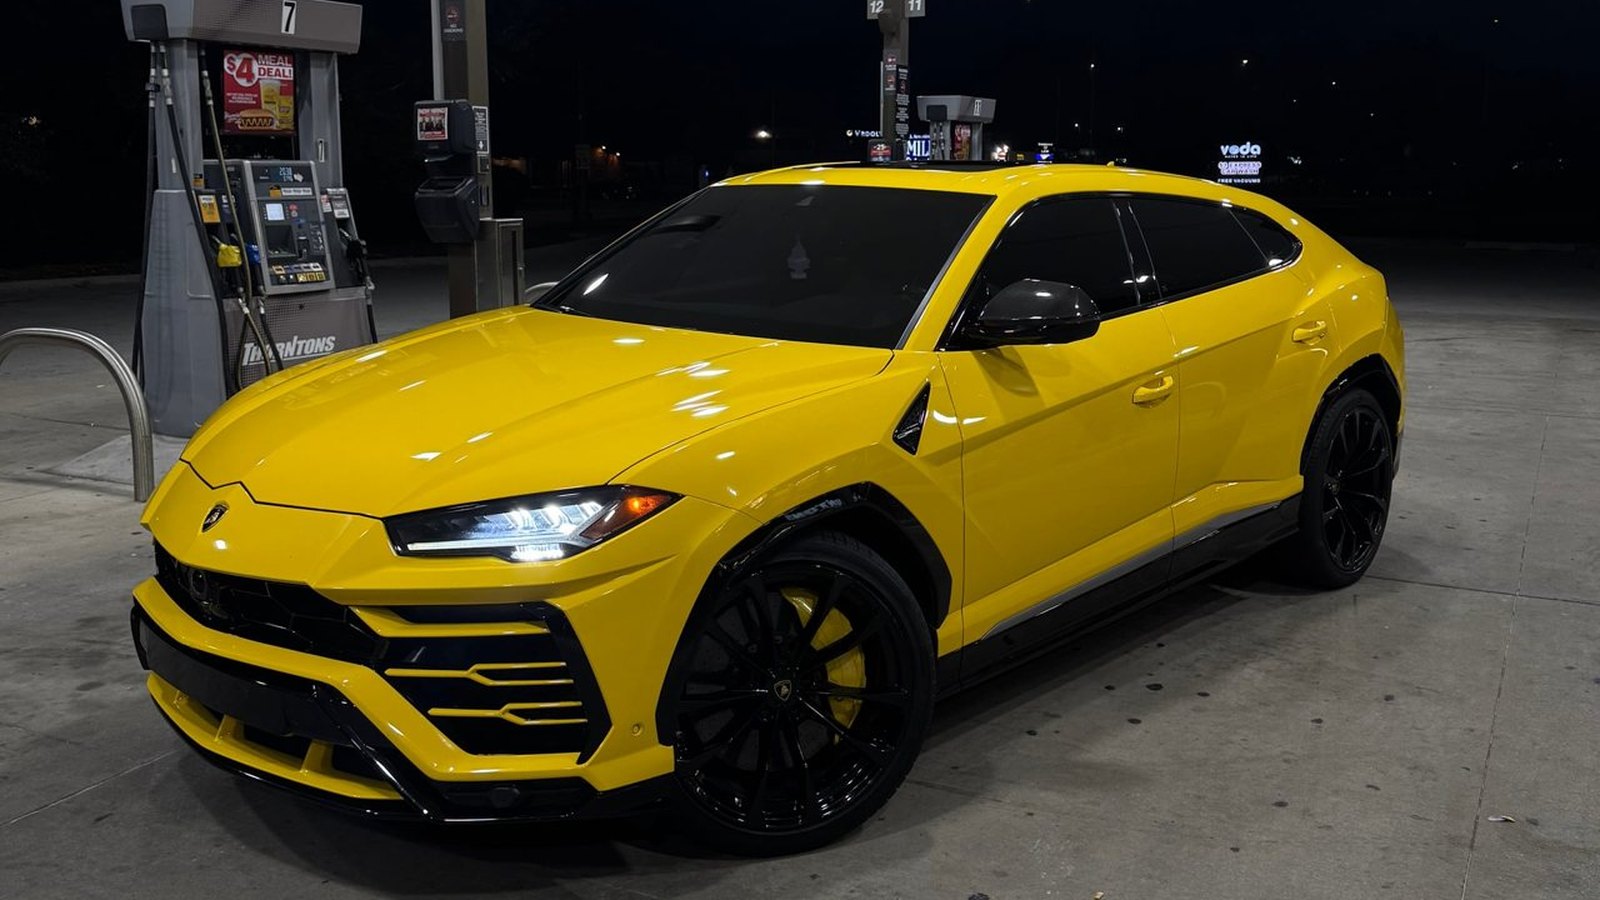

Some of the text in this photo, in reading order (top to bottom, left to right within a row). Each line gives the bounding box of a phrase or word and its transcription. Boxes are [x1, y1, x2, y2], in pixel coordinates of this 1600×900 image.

[870, 0, 884, 13] 12
[908, 0, 921, 11] 11
[284, 2, 296, 32] 7
[257, 54, 292, 66] MEAL
[227, 56, 255, 83] $4
[258, 67, 292, 78] DEAL!
[906, 139, 931, 157] MIL
[1220, 141, 1261, 156] voda
